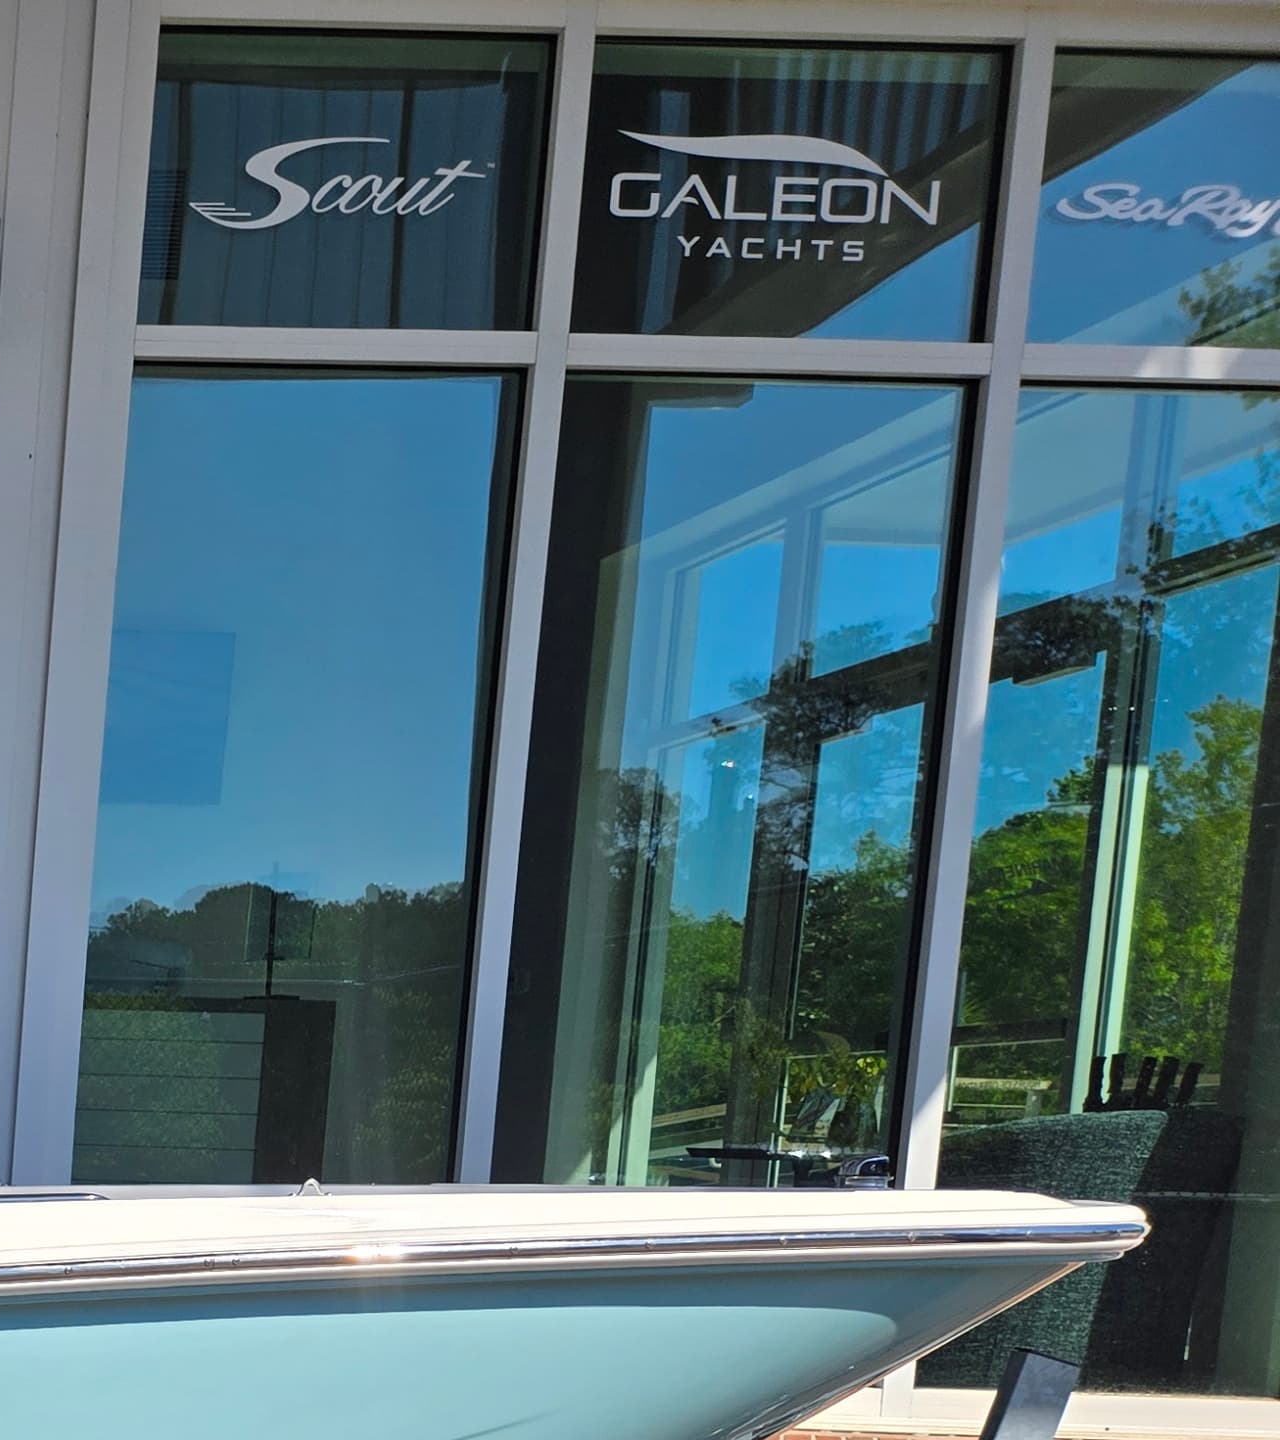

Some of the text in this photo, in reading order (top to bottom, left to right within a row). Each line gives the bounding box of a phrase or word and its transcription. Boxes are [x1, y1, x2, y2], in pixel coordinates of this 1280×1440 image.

[189, 137, 486, 229] Scout
[608, 171, 941, 225] GALEON
[677, 235, 865, 262] YACHTS
